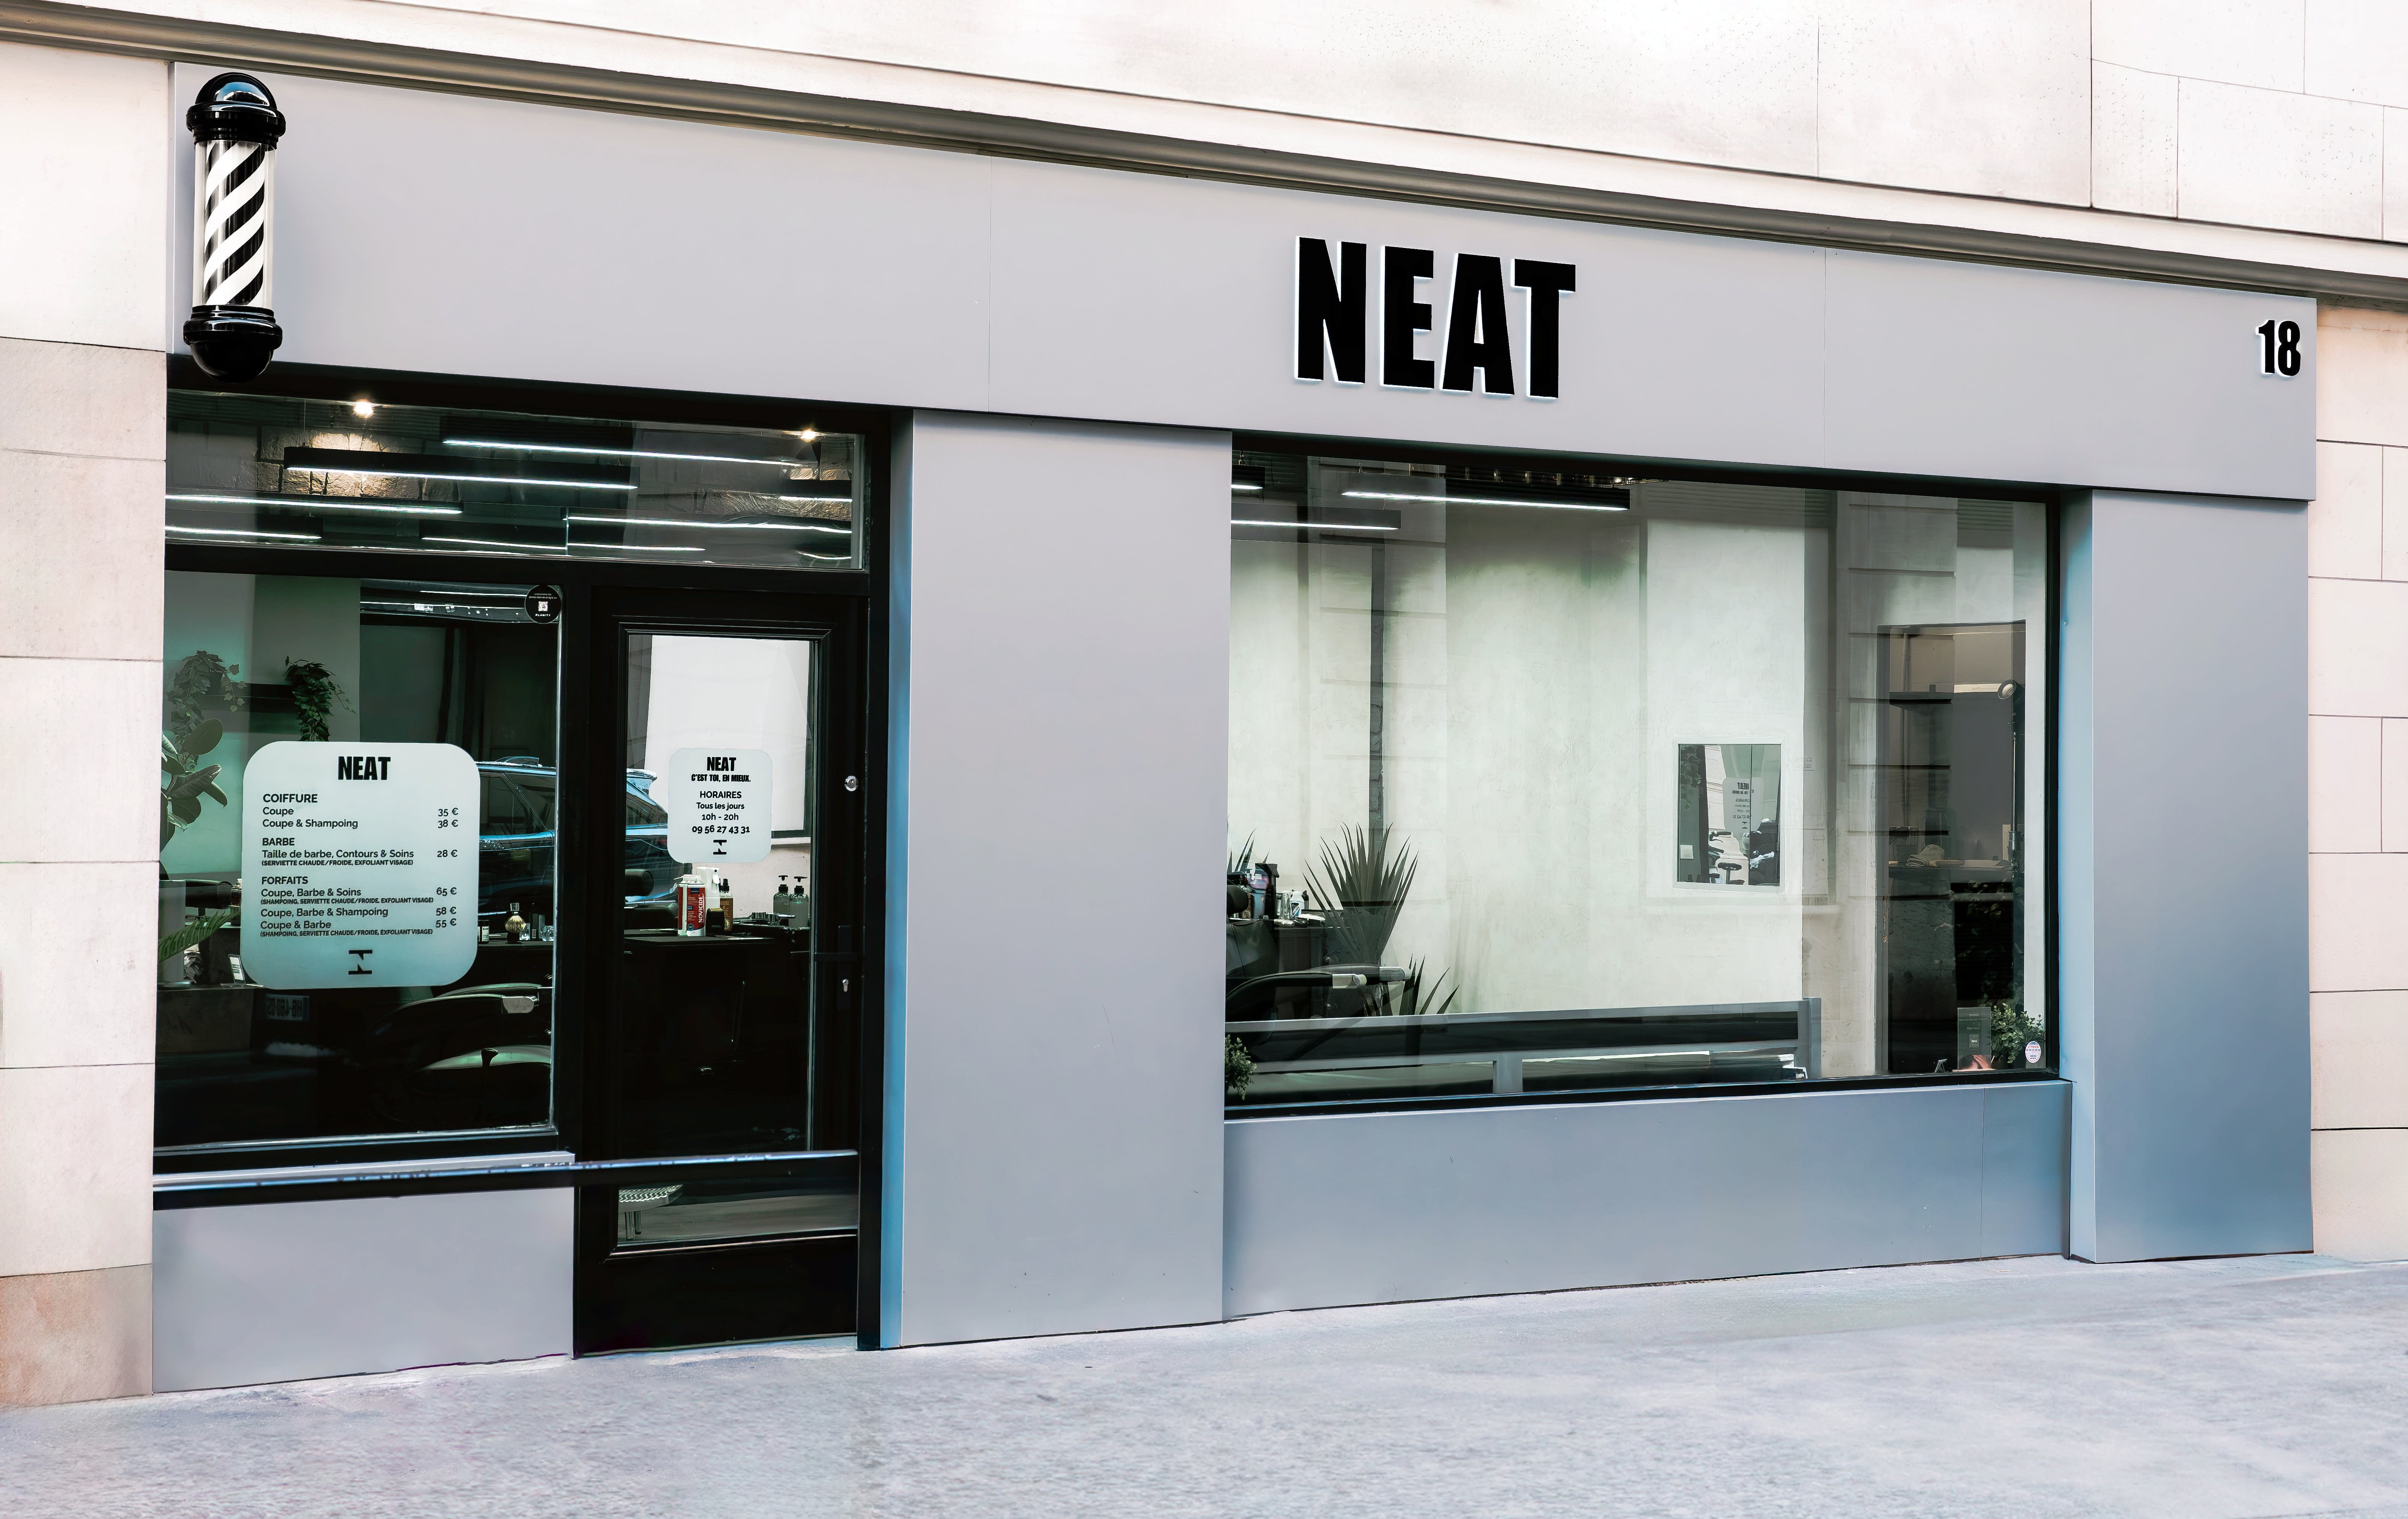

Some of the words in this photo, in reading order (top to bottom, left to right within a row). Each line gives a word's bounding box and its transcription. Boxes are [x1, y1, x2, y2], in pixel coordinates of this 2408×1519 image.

[1294, 236, 1576, 399] NEAT
[2255, 319, 2301, 377] 18
[338, 756, 391, 780] NEAT
[707, 757, 736, 771] NEAT
[263, 794, 317, 803] COIFFURE
[263, 807, 294, 816] Coupe
[263, 819, 293, 829] Coupe
[306, 819, 358, 829] Shampoing
[438, 819, 448, 828] 38
[705, 825, 714, 834] 56
[262, 850, 287, 858] Taille
[304, 850, 334, 858] barbe,
[262, 876, 308, 885] FORFAITS
[261, 889, 294, 898] Coupe,
[437, 887, 447, 896] 65
[261, 909, 293, 919] Coupe,
[336, 907, 388, 917] Shampoing
[436, 907, 446, 916] 58
[261, 921, 292, 930] Coupe
[304, 920, 331, 929] Barbe
